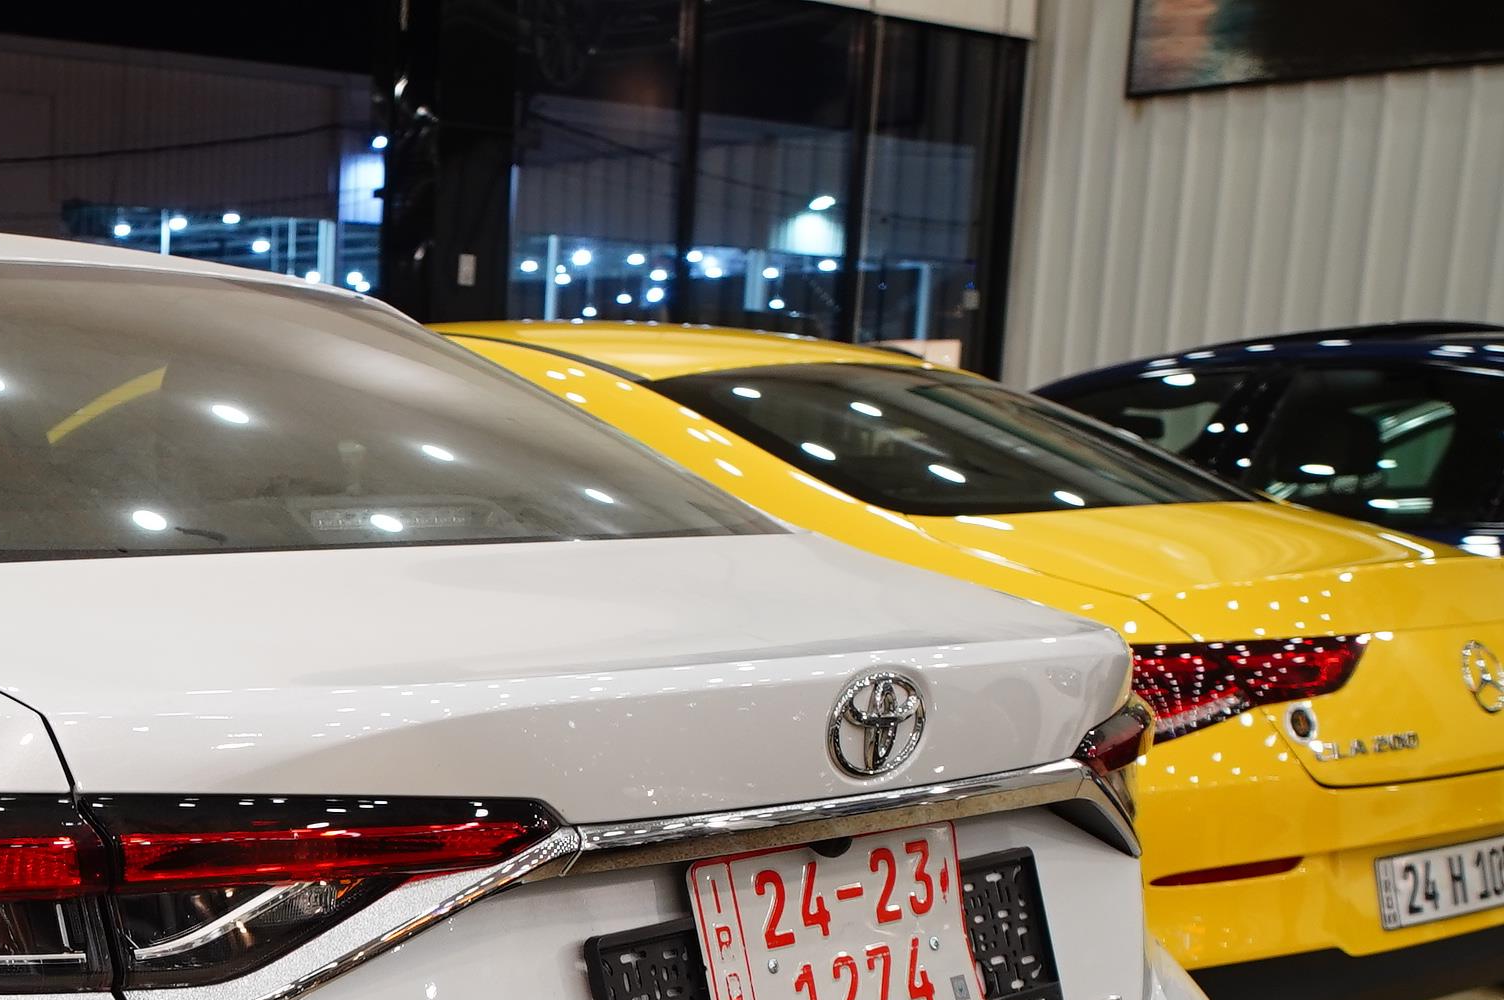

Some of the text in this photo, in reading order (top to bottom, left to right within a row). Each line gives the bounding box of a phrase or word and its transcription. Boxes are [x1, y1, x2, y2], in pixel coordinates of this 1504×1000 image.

[1402, 845, 1504, 916] 24 H 10
